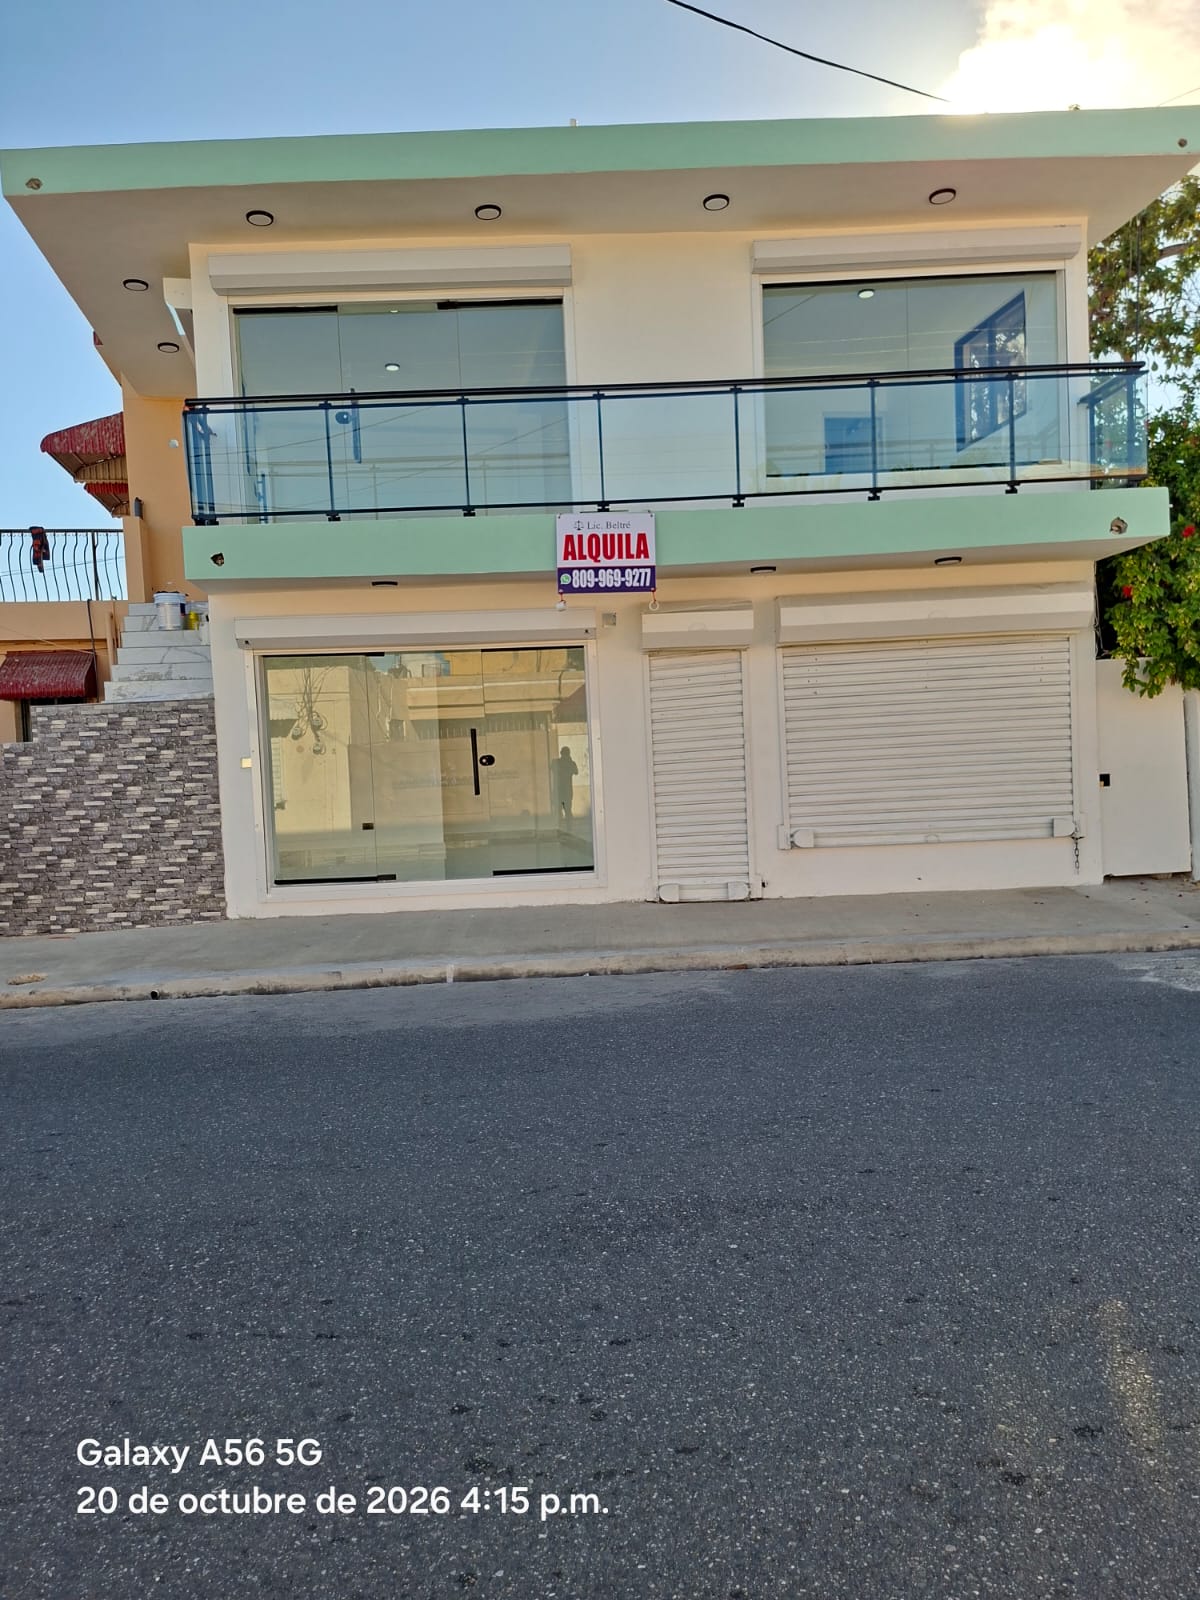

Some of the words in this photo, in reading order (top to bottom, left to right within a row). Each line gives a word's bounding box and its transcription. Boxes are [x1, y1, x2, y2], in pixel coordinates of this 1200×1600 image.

[587, 521, 603, 530] Lic.
[606, 520, 631, 530] Beltré
[563, 532, 649, 563] ALQUILA
[572, 568, 651, 588] 809-969-9277
